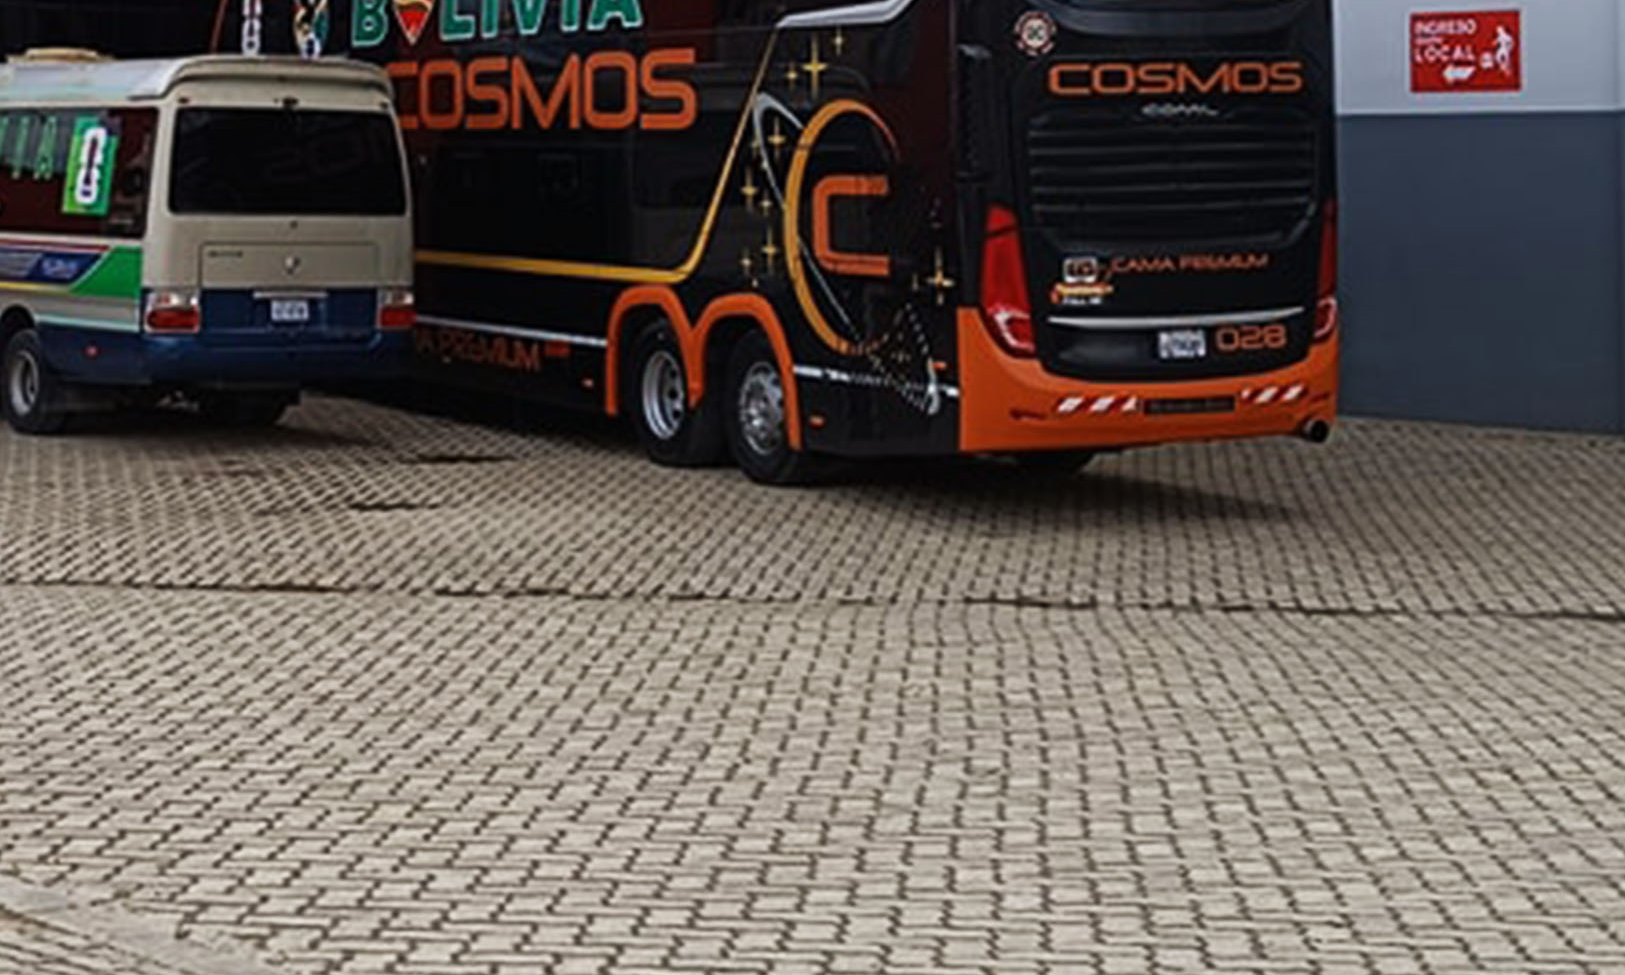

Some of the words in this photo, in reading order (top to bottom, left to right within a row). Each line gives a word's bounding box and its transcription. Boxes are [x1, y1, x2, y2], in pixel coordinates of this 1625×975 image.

[1415, 44, 1475, 63] LOCAL
[1048, 61, 1304, 96] COSMOS
[1215, 324, 1288, 350] 028
